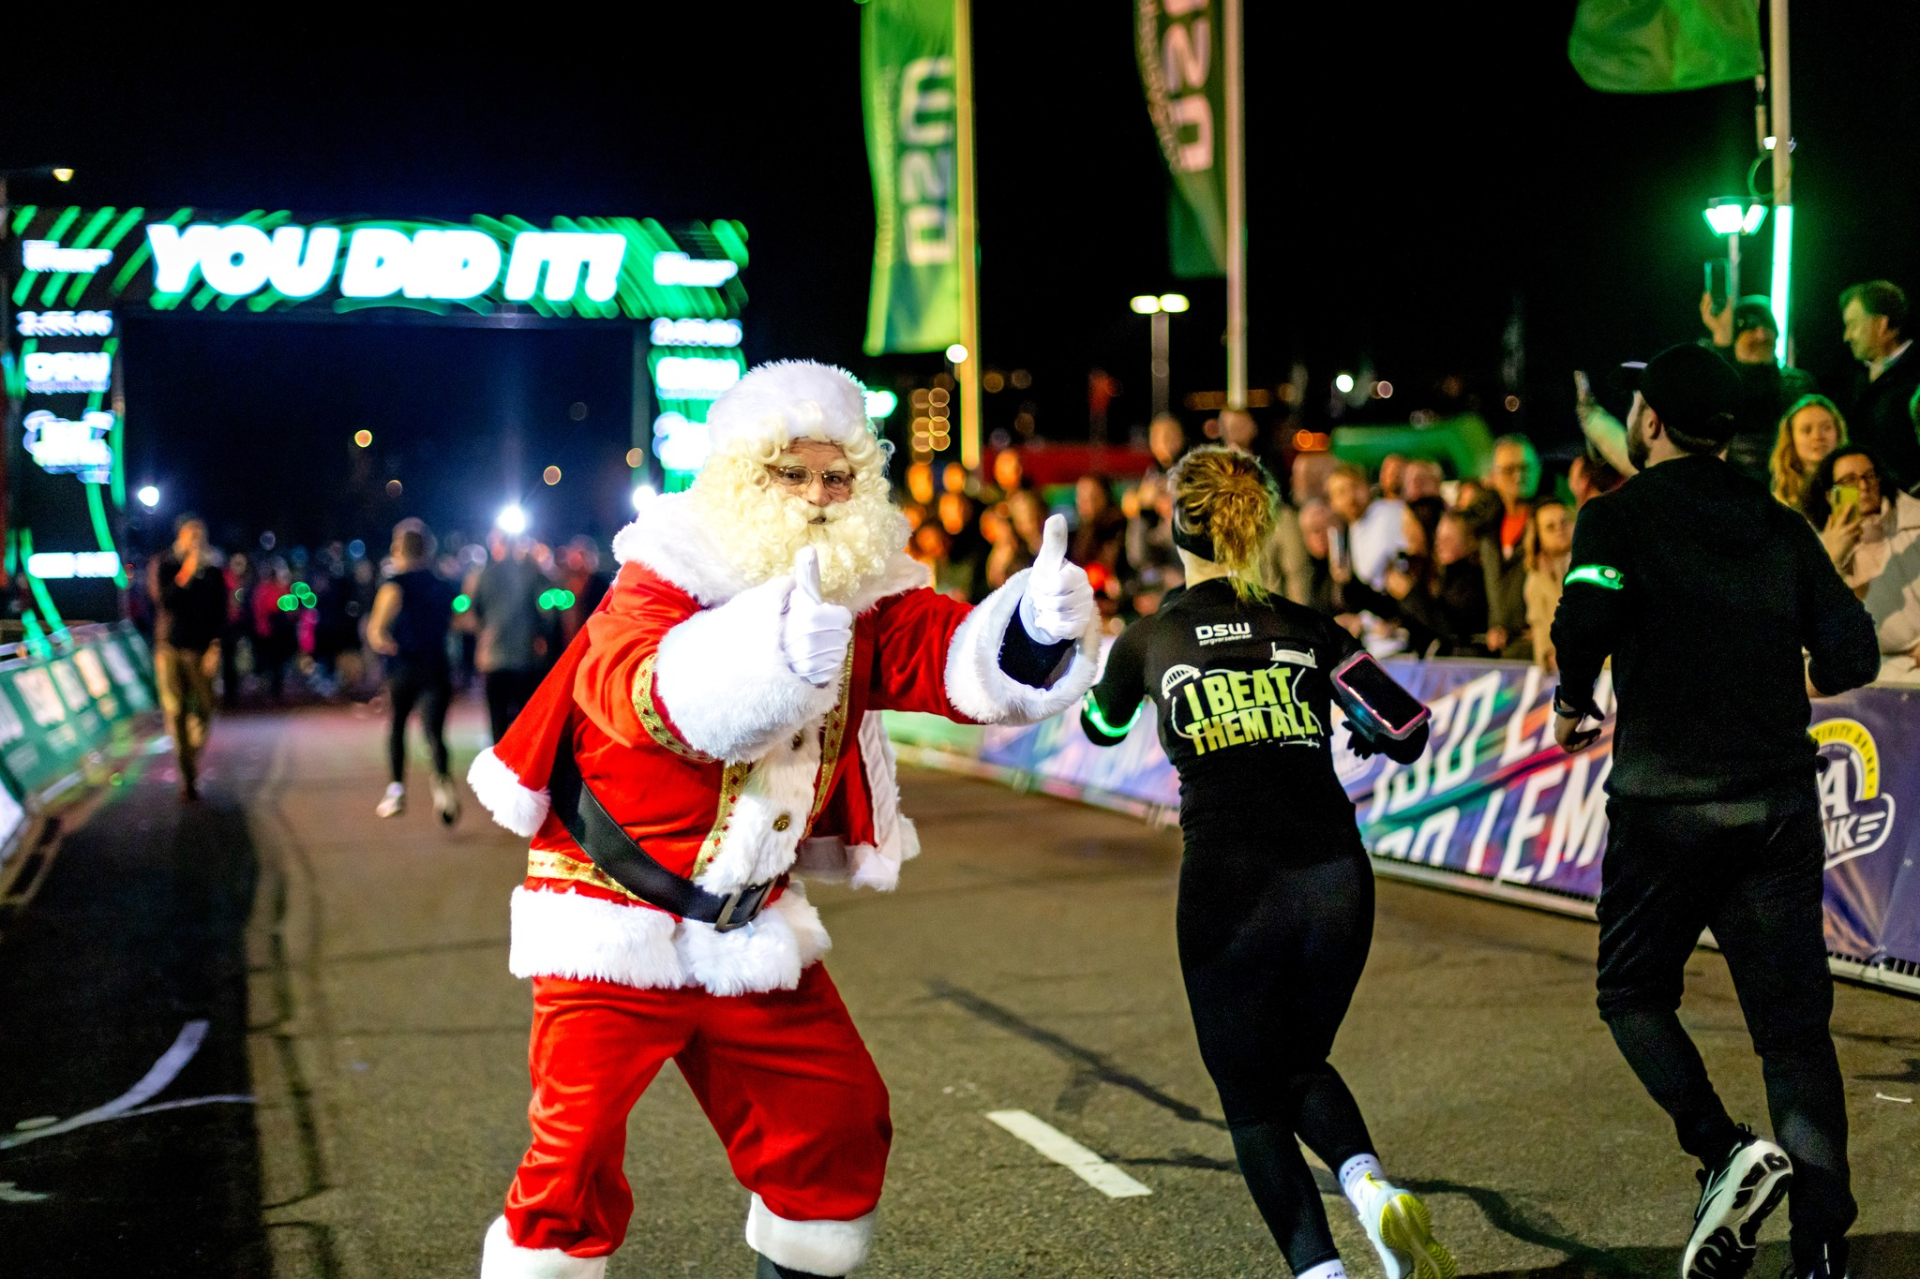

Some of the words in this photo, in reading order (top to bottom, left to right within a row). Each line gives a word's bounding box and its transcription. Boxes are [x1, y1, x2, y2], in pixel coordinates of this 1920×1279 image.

[147, 223, 341, 298] YOU
[340, 227, 502, 300] DID
[503, 230, 627, 302] IT!
[1195, 621, 1251, 640] DSW
[1183, 682, 1205, 722] I
[1202, 667, 1291, 716] BEAT
[1185, 706, 1269, 756] THEM
[1270, 701, 1318, 738] ALL
